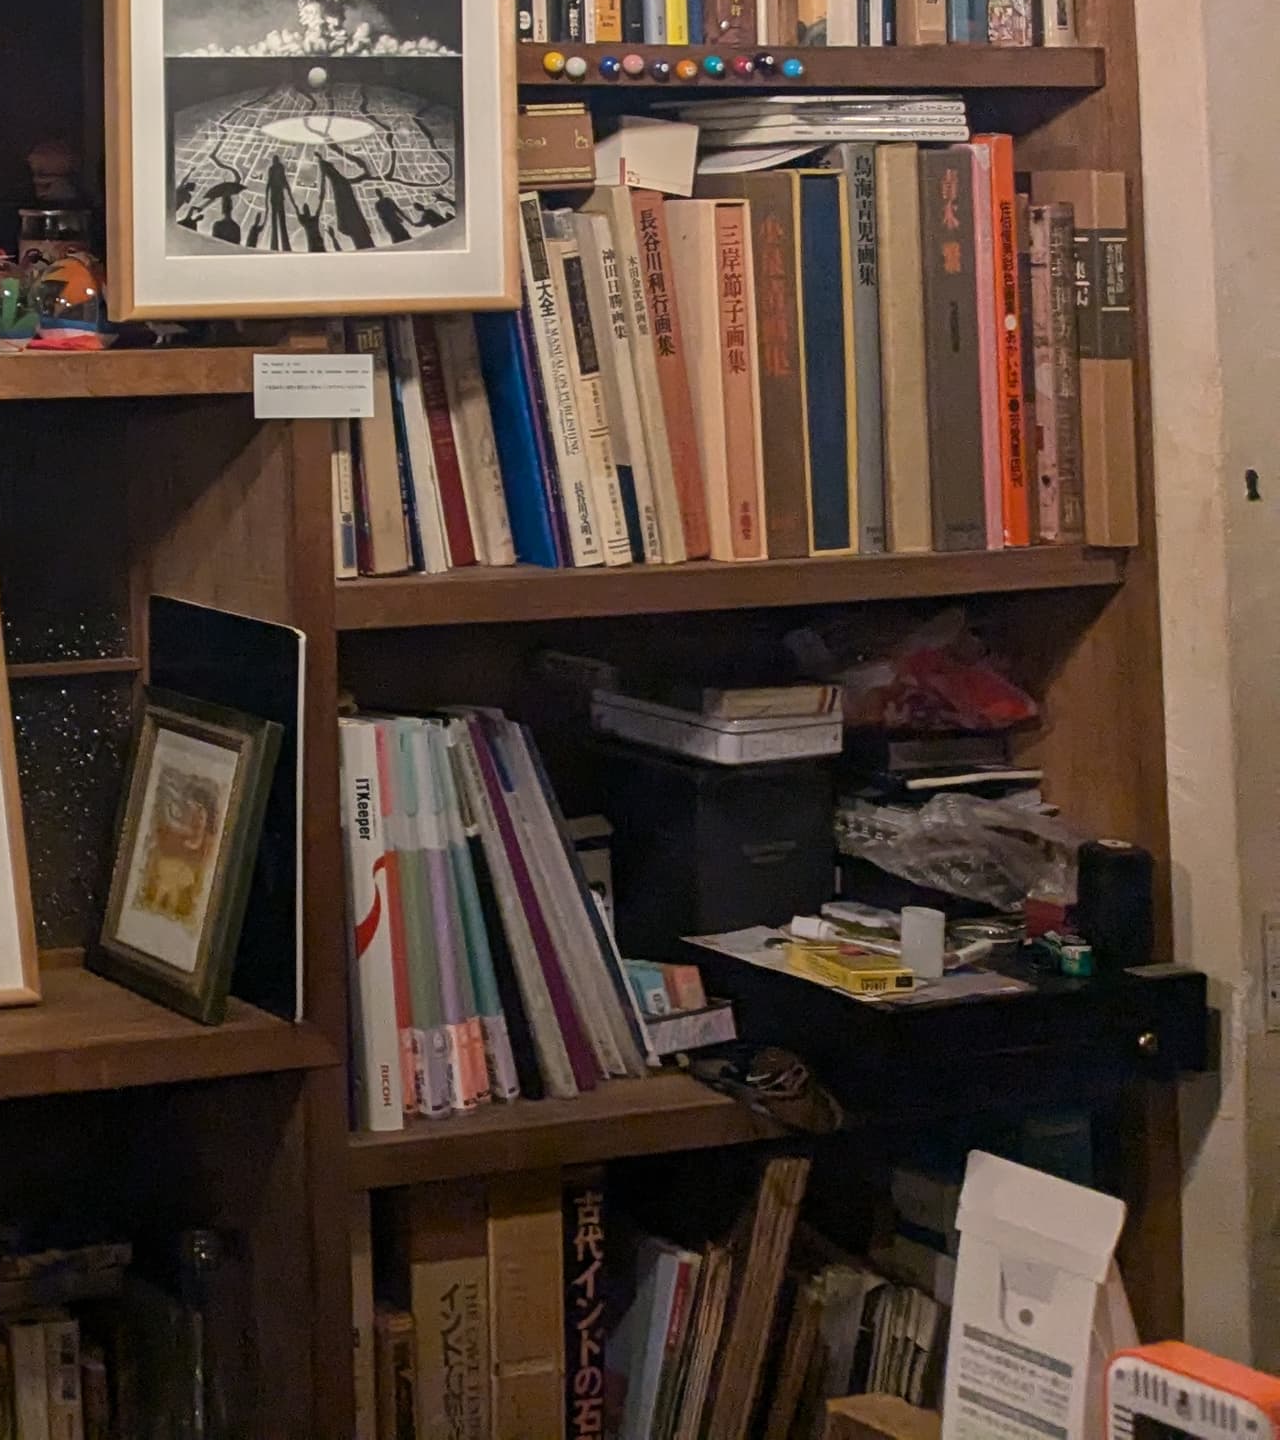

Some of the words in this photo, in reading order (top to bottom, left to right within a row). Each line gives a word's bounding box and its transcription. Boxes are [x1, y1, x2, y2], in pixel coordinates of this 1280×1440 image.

[853, 155, 876, 287] 鳥海青児画集
[535, 279, 555, 319] 大全
[601, 247, 629, 340] 神田日勝画集
[638, 208, 677, 358] 長谷川利行画集
[720, 223, 747, 374] 三岸節子画集
[355, 777, 371, 841] ITKeeper
[380, 1064, 392, 1108] RICOH
[573, 1190, 605, 1440] 古代インドの石
